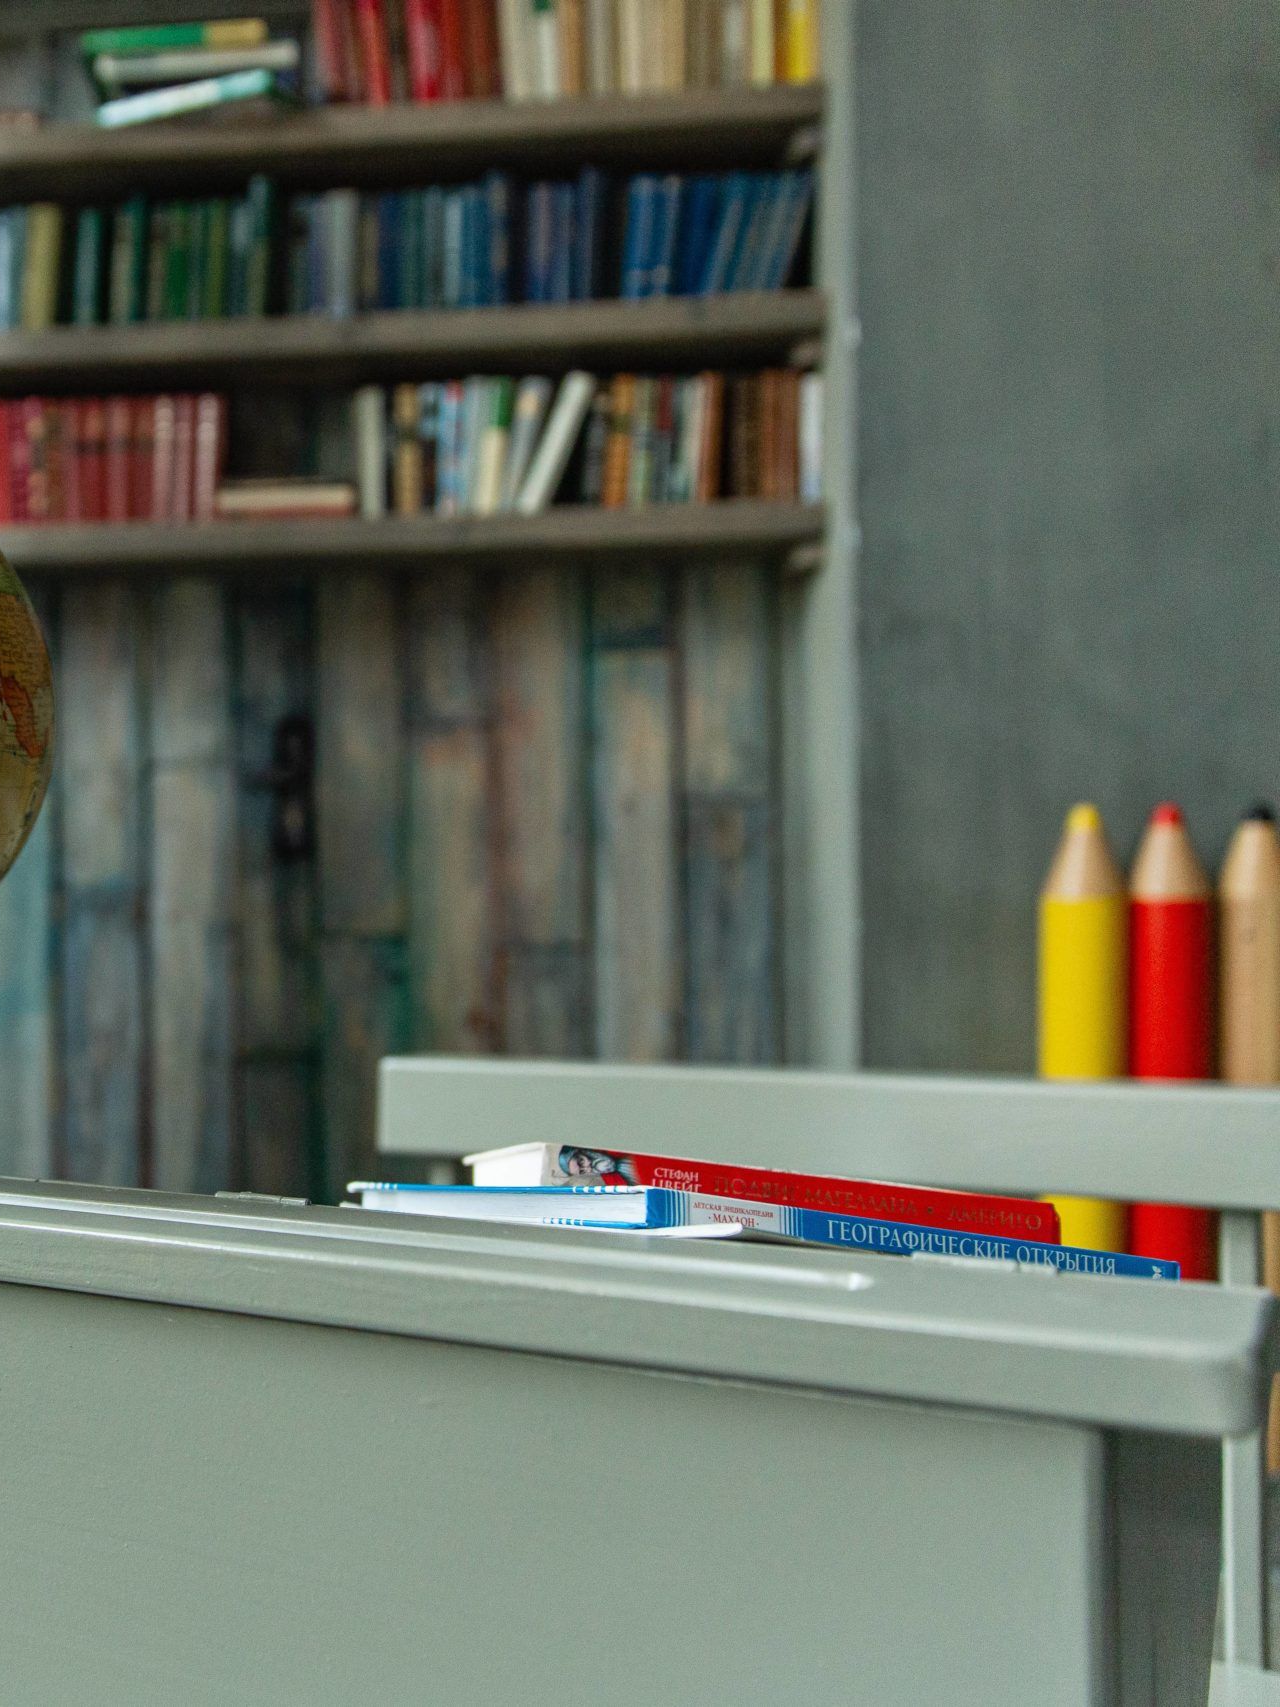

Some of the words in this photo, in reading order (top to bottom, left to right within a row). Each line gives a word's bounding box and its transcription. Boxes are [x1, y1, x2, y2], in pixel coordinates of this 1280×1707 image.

[654, 1167, 699, 1183] СТЕФАН
[692, 1202, 721, 1212] ДЕТСКАЯ
[723, 1205, 774, 1218] ЭНЦИКЛОПЕДИЯ
[827, 1219, 1011, 1260] ГЕОГРАФИЧЕСКИЕ
[1016, 1245, 1116, 1276] ОТКРЫТИЯ
